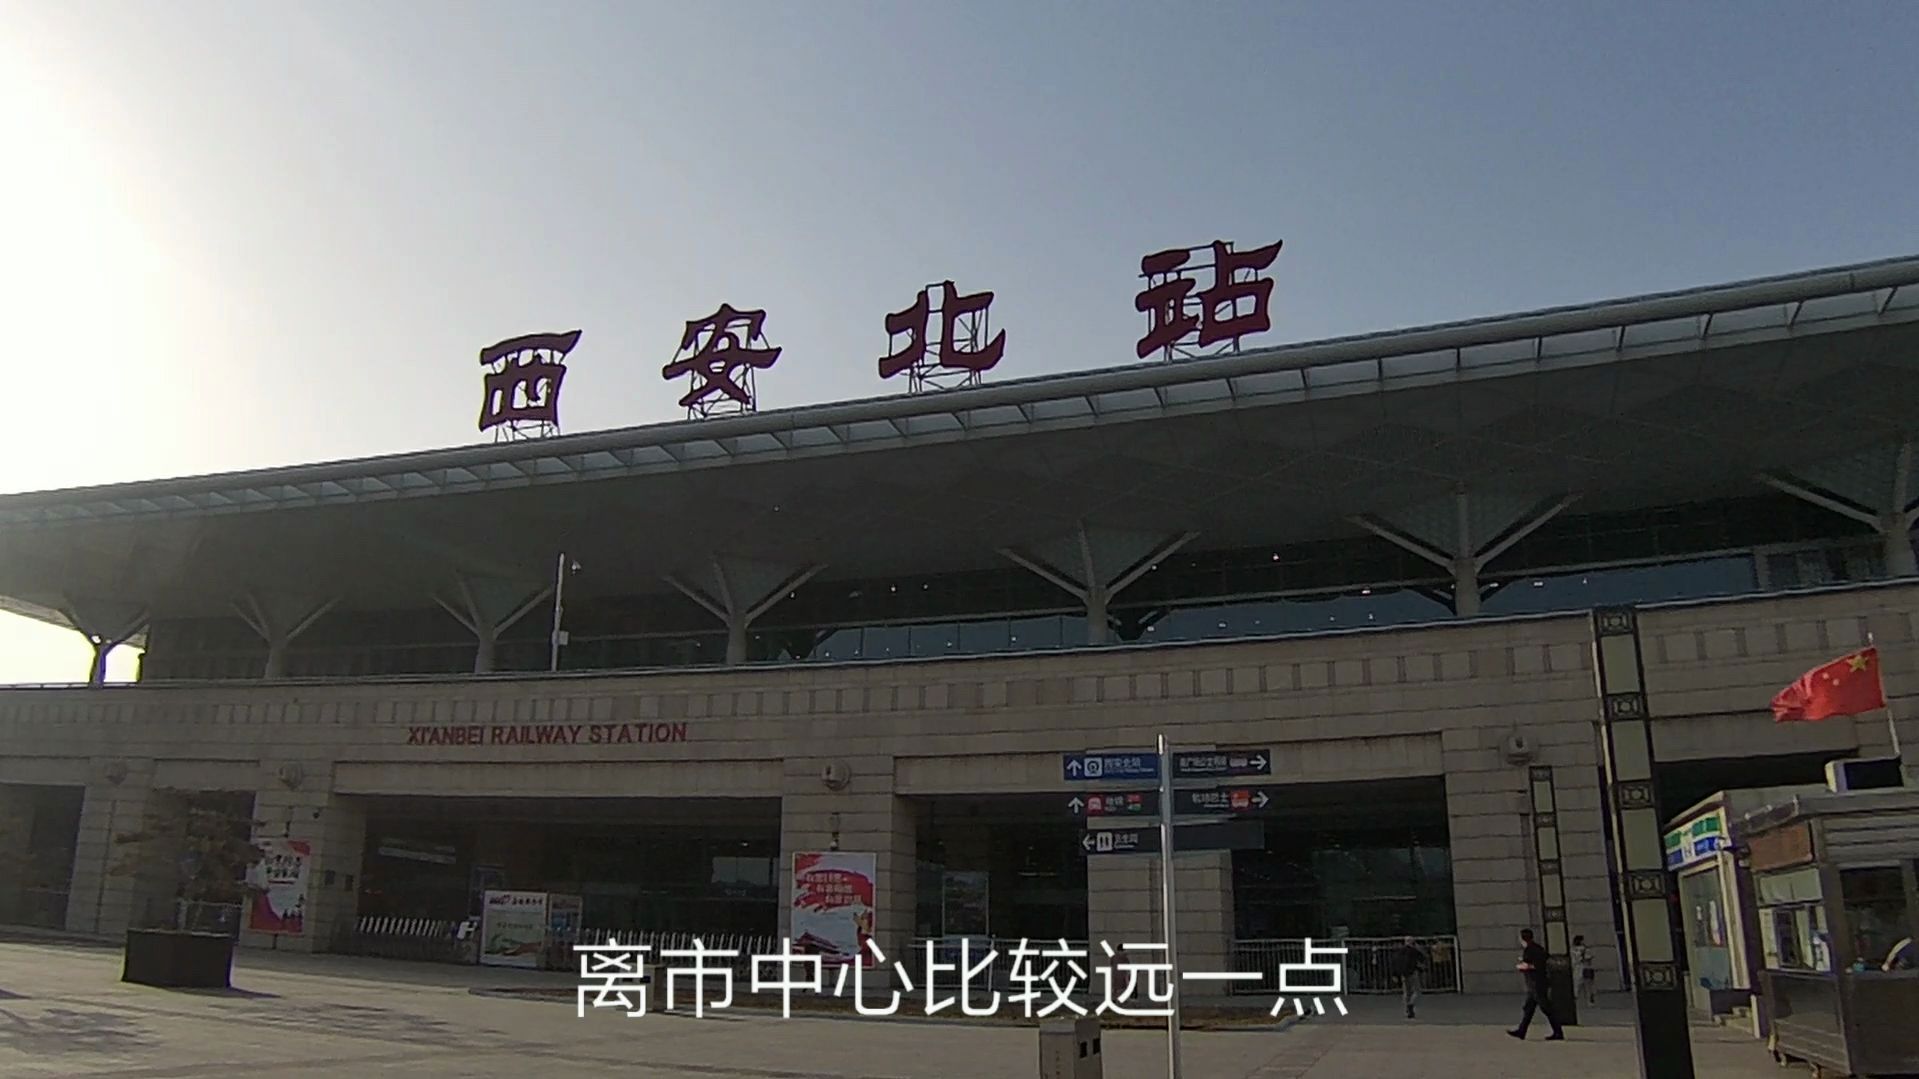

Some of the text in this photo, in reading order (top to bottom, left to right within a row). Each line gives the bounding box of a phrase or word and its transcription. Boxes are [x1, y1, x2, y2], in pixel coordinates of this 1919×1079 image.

[479, 239, 1283, 431] 西安北站
[490, 724, 583, 745] RAILWAY
[589, 722, 688, 744] STATION
